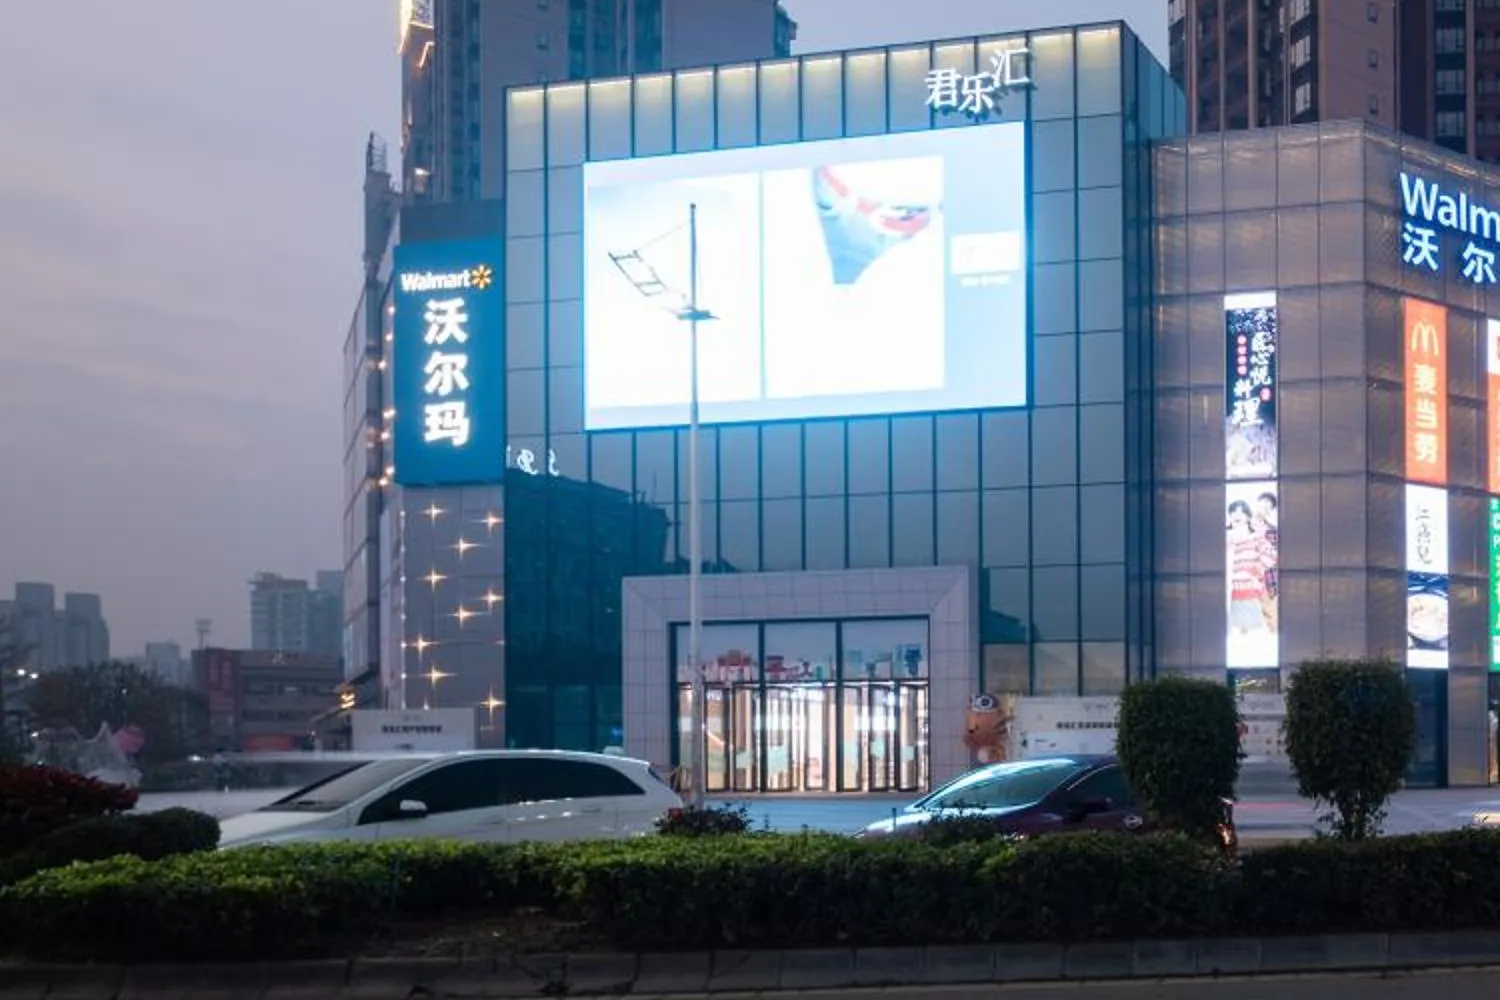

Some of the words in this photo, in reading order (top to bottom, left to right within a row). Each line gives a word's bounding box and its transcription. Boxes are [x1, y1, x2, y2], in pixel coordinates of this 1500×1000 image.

[924, 48, 1029, 114] 君乐汇
[401, 269, 470, 291] Walmart
[424, 297, 469, 446] 沃尔玛
